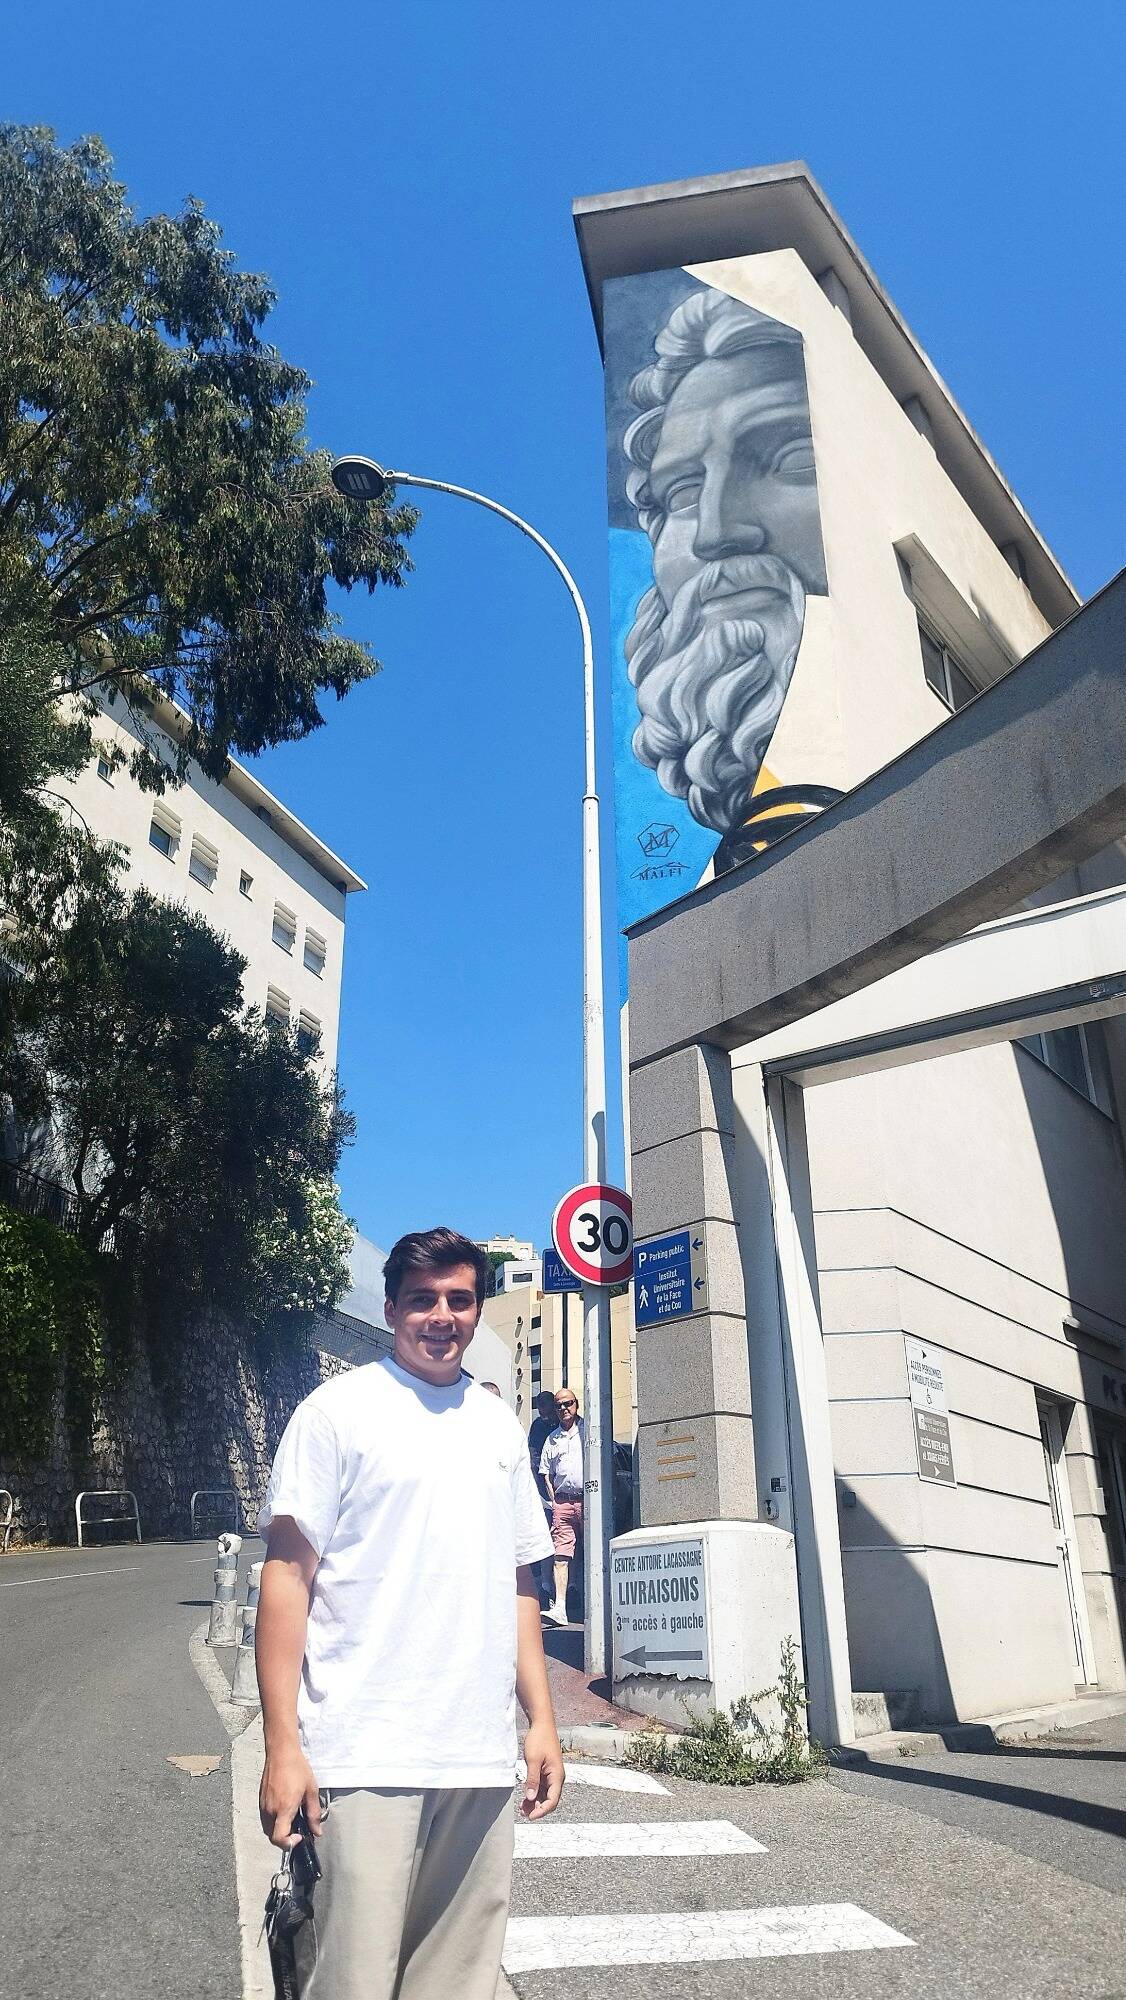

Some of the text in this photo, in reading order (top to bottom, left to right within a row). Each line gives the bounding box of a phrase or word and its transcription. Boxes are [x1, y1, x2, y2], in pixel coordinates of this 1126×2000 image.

[639, 868, 681, 880] MALFI
[576, 1212, 629, 1255] 30
[638, 1245, 685, 1269] P Parking public
[547, 1264, 572, 1278] TAX
[658, 1268, 678, 1281] Institut
[653, 1278, 686, 1294] Universitaire
[656, 1290, 682, 1304] de la Face
[658, 1300, 682, 1314] et du Cou
[614, 1549, 702, 1574] CENTRE ANTOINE LACASSAGNE
[618, 1575, 700, 1606] LIVRAISONS
[632, 1613, 658, 1632] accès
[661, 1612, 667, 1630] à
[670, 1612, 704, 1634] gauche
